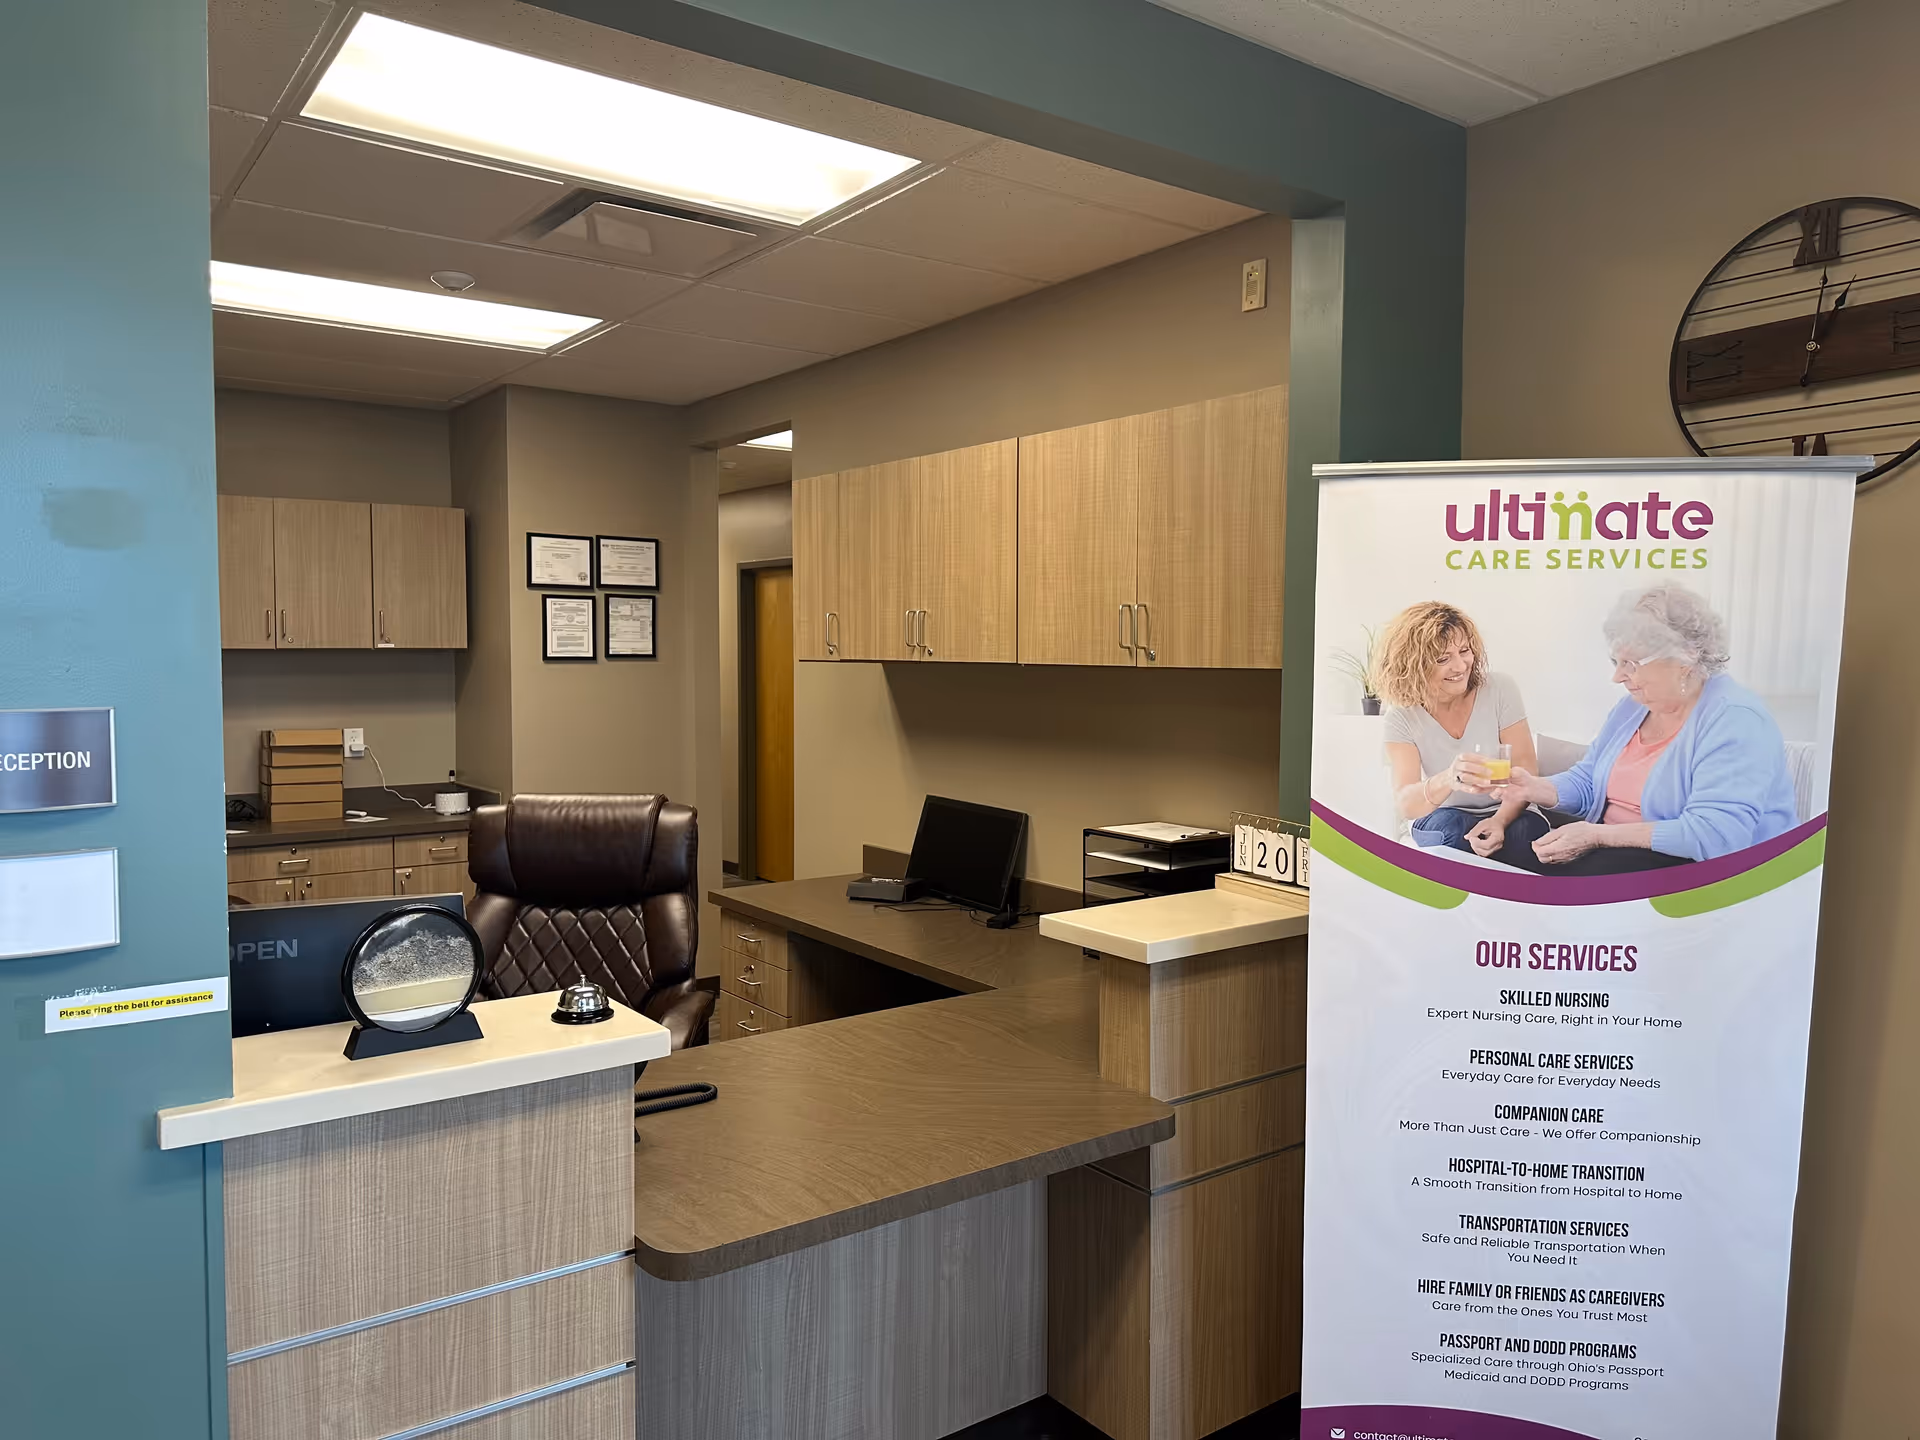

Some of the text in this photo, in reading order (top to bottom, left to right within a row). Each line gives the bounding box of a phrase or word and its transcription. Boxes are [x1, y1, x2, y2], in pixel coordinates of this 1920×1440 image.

[1445, 548, 1708, 570] CARE SERVICES
[0, 750, 91, 772] CEPTION
[1239, 832, 1247, 866] JUN
[1256, 841, 1289, 875] 20
[1475, 940, 1638, 972] OUR SERVICES
[94, 1005, 112, 1014] ring
[114, 1003, 129, 1012] the
[132, 1000, 150, 1010] bell
[151, 999, 164, 1007] for
[166, 993, 214, 1005] assistance
[1499, 989, 1610, 1008] SKILLED NURSING
[1427, 1007, 1683, 1029] Expert Nursing Care, Right in Your Home
[1469, 1048, 1634, 1070] PERSONAL CARE SERVICES
[1441, 1069, 1661, 1089] Everyday Care for Everyday Needs
[1494, 1104, 1605, 1123] COMPANION CARE
[1399, 1119, 1430, 1131] More
[1433, 1121, 1464, 1133] Than
[1467, 1124, 1497, 1135] Just
[1499, 1125, 1530, 1137] Care
[1542, 1128, 1562, 1139] We
[1565, 1128, 1597, 1140] Offer
[1599, 1130, 1701, 1147] Companionship
[1448, 1157, 1645, 1182] HOSPITAL-TO-HOME TRANSITION
[1410, 1176, 1683, 1201] A Smooth Transition from Hospital to Home
[1458, 1214, 1629, 1238] TRANSPORTATION SERVICES
[1421, 1232, 1665, 1256] Safe and Reliable Transportation When
[1507, 1252, 1577, 1266] You Need It
[1417, 1278, 1665, 1308] HIRE FAMILY OR FRIENDS AS CAREGIVERS
[1431, 1300, 1648, 1323] Care from the Ones You Trust Most
[1439, 1332, 1637, 1359] PASSPORT AND DODD PROGRAMS
[1411, 1351, 1664, 1378] Specialized Care through Ohio's Passport
[1444, 1369, 1629, 1391] Medicaid and DODD Programs
